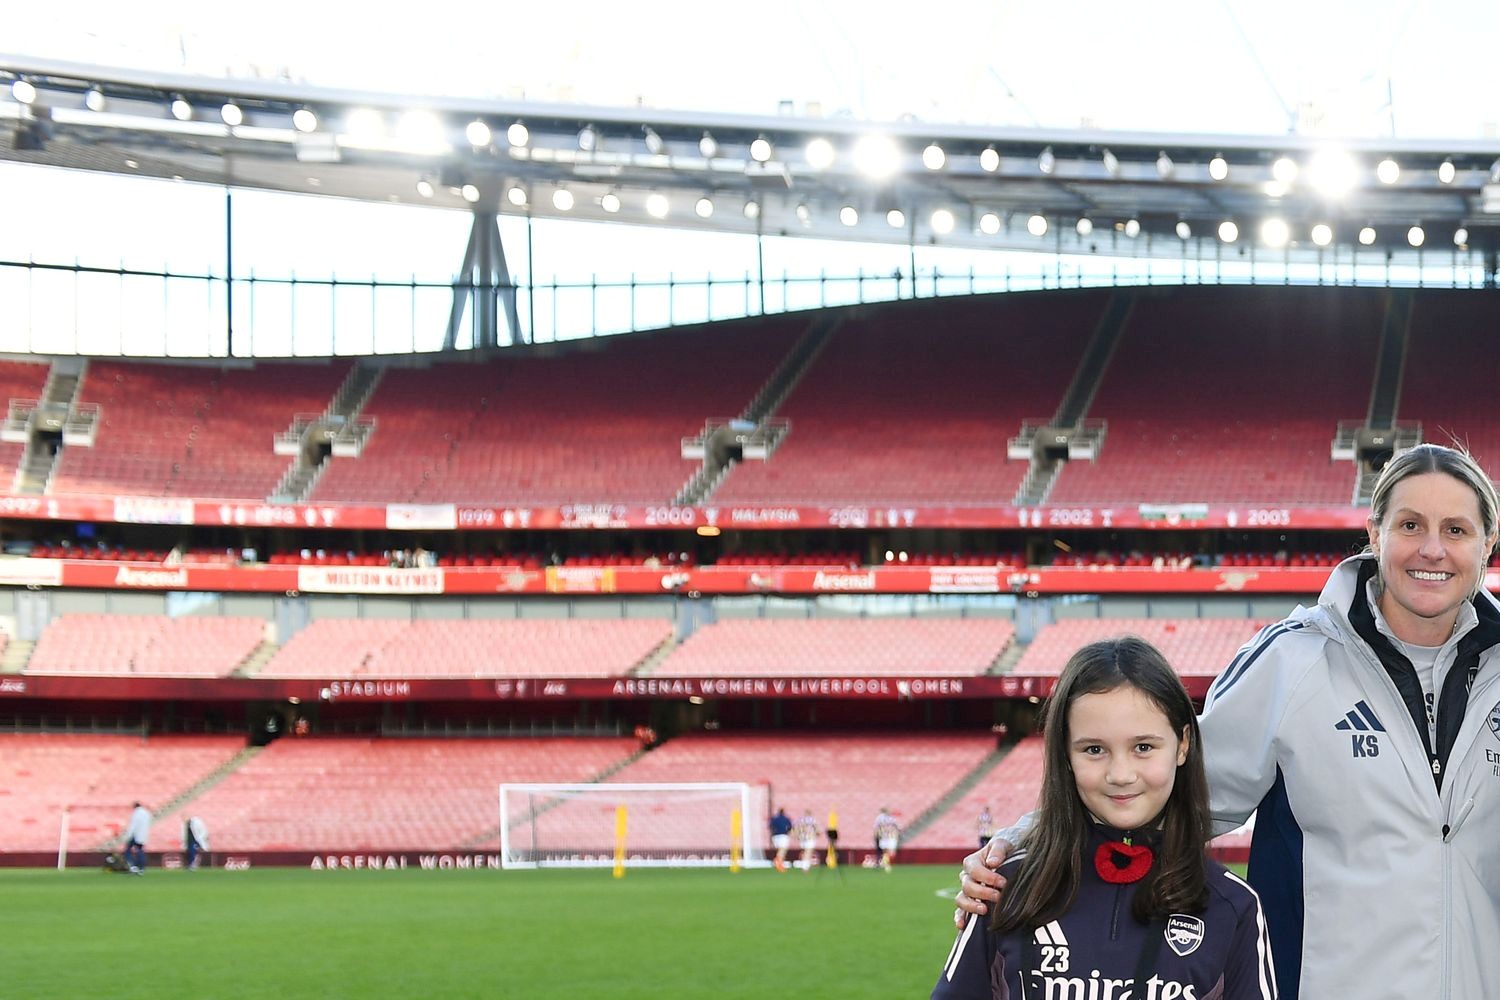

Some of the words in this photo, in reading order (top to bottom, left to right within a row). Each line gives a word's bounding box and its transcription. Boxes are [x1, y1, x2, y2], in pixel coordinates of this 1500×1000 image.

[0, 497, 40, 512] 997
[645, 506, 696, 525] 2000
[731, 508, 799, 523] MALAYSIA
[1050, 508, 1093, 526] 2002
[1248, 509, 1290, 525] 2003
[115, 565, 188, 586] Arsenal
[326, 573, 380, 586] MILTON
[813, 571, 876, 590] Arsenal
[331, 681, 410, 696] STADIUM
[612, 680, 693, 694] ARSENAL
[700, 680, 768, 694] WOMEN
[773, 680, 786, 694] V
[791, 680, 889, 694] LIVERPOOL
[896, 679, 963, 694] WOMEN
[1352, 734, 1380, 757] KS
[310, 856, 408, 871] ARSENAL
[419, 855, 499, 870] WOMEN
[1171, 919, 1199, 931] Arsenal
[1041, 946, 1069, 972] 23
